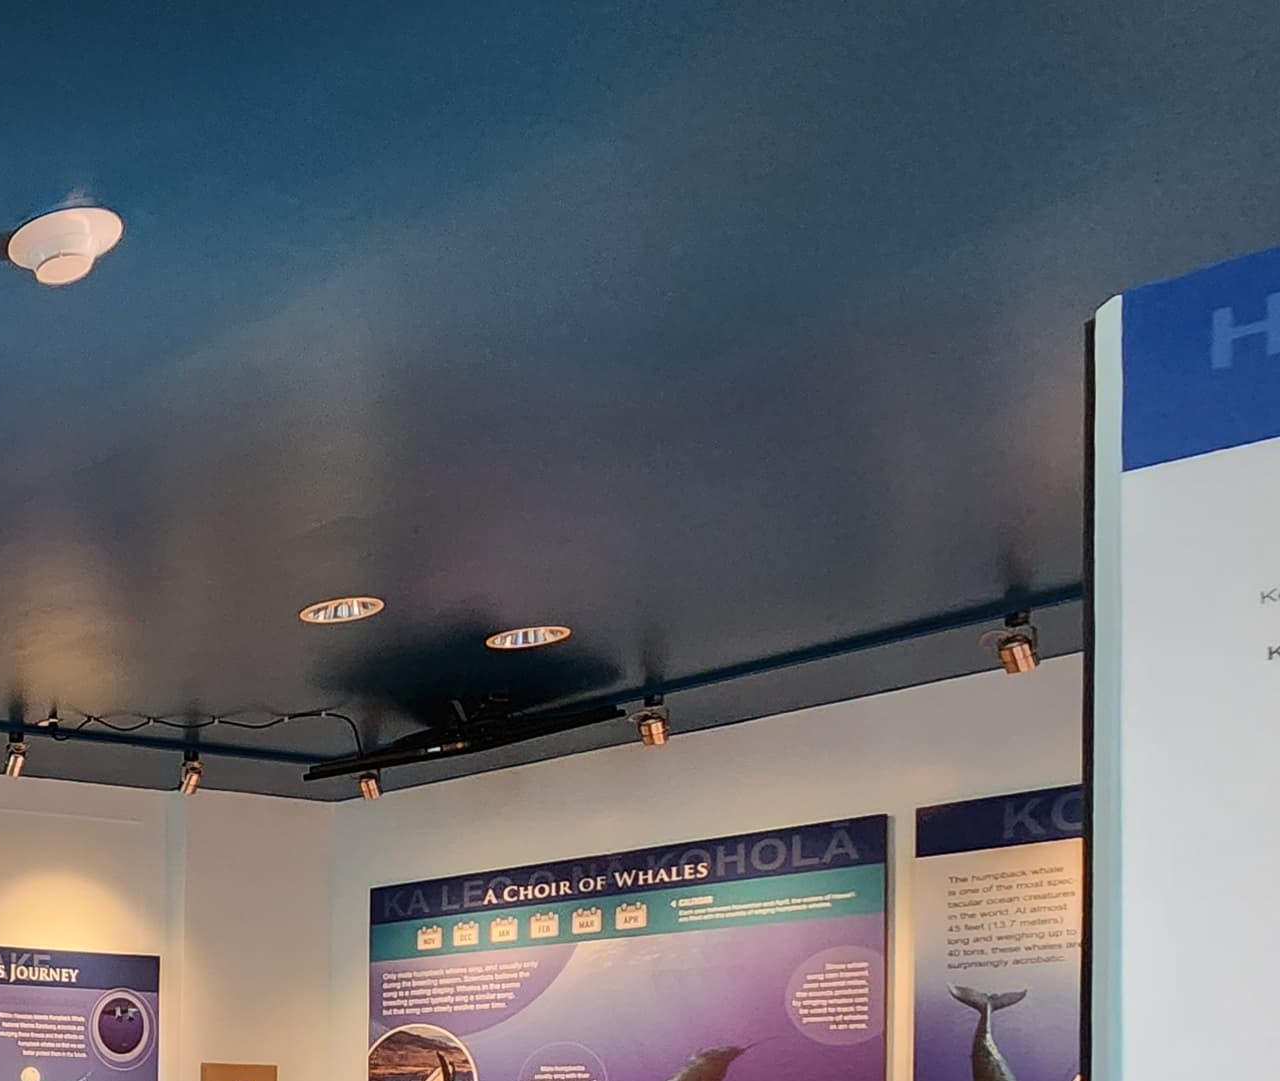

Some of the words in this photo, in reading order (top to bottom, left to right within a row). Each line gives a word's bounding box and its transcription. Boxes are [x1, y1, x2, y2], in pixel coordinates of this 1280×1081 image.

[1260, 587, 1280, 605] K
[948, 874, 968, 883] The
[971, 868, 1026, 883] humpback
[1030, 864, 1064, 875] whale
[482, 890, 498, 906] A
[503, 881, 572, 903] CHOIR
[579, 876, 607, 892] OF
[614, 862, 710, 889] WHALES
[948, 888, 955, 896] is
[983, 884, 992, 893] of
[996, 882, 1012, 891] the
[1016, 879, 1043, 889] most
[948, 897, 982, 908] tacular
[987, 896, 1020, 904] ocean
[1023, 888, 1075, 901] creatures
[948, 911, 957, 920] in
[960, 910, 976, 919] the
[1016, 906, 1026, 914] At
[1030, 902, 1068, 913] almost
[579, 920, 595, 929] MAR
[948, 923, 960, 932] 45
[964, 922, 984, 931] feet
[1020, 916, 1064, 929] meters)
[423, 938, 436, 946] NOV
[948, 934, 969, 946] long
[973, 933, 992, 942] and
[996, 929, 1045, 942] weighing
[1049, 930, 1062, 939] up
[1067, 927, 1077, 935] to
[948, 948, 960, 957] 40
[991, 944, 1021, 954] these
[1025, 941, 1062, 951] whales
[948, 957, 1008, 971] surprisingly
[9, 964, 79, 983] JOURNEY
